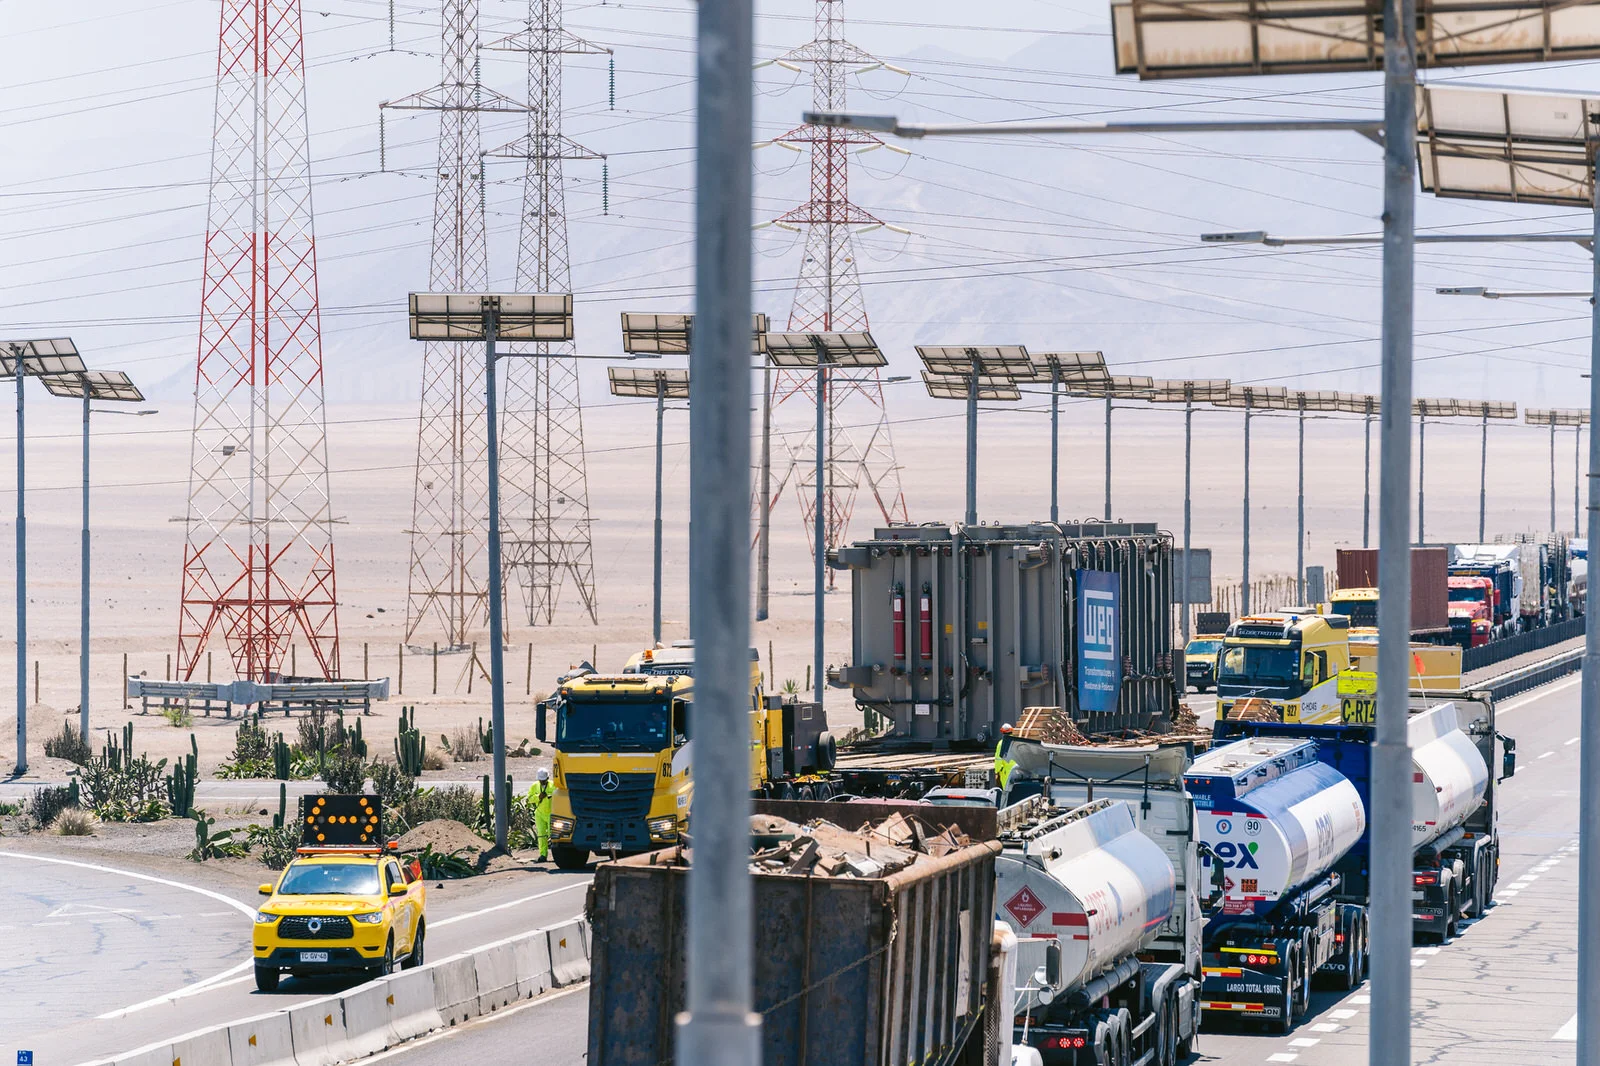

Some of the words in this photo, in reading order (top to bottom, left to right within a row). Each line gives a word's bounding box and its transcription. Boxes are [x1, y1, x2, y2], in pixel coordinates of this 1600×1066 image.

[1287, 704, 1297, 717] 927
[1342, 699, 1377, 723] C-RT4
[662, 762, 672, 778] 872
[1247, 821, 1259, 831] 90
[1322, 963, 1346, 971] LVO
[1227, 984, 1245, 992] LARGO
[1246, 984, 1262, 992] TOTAL
